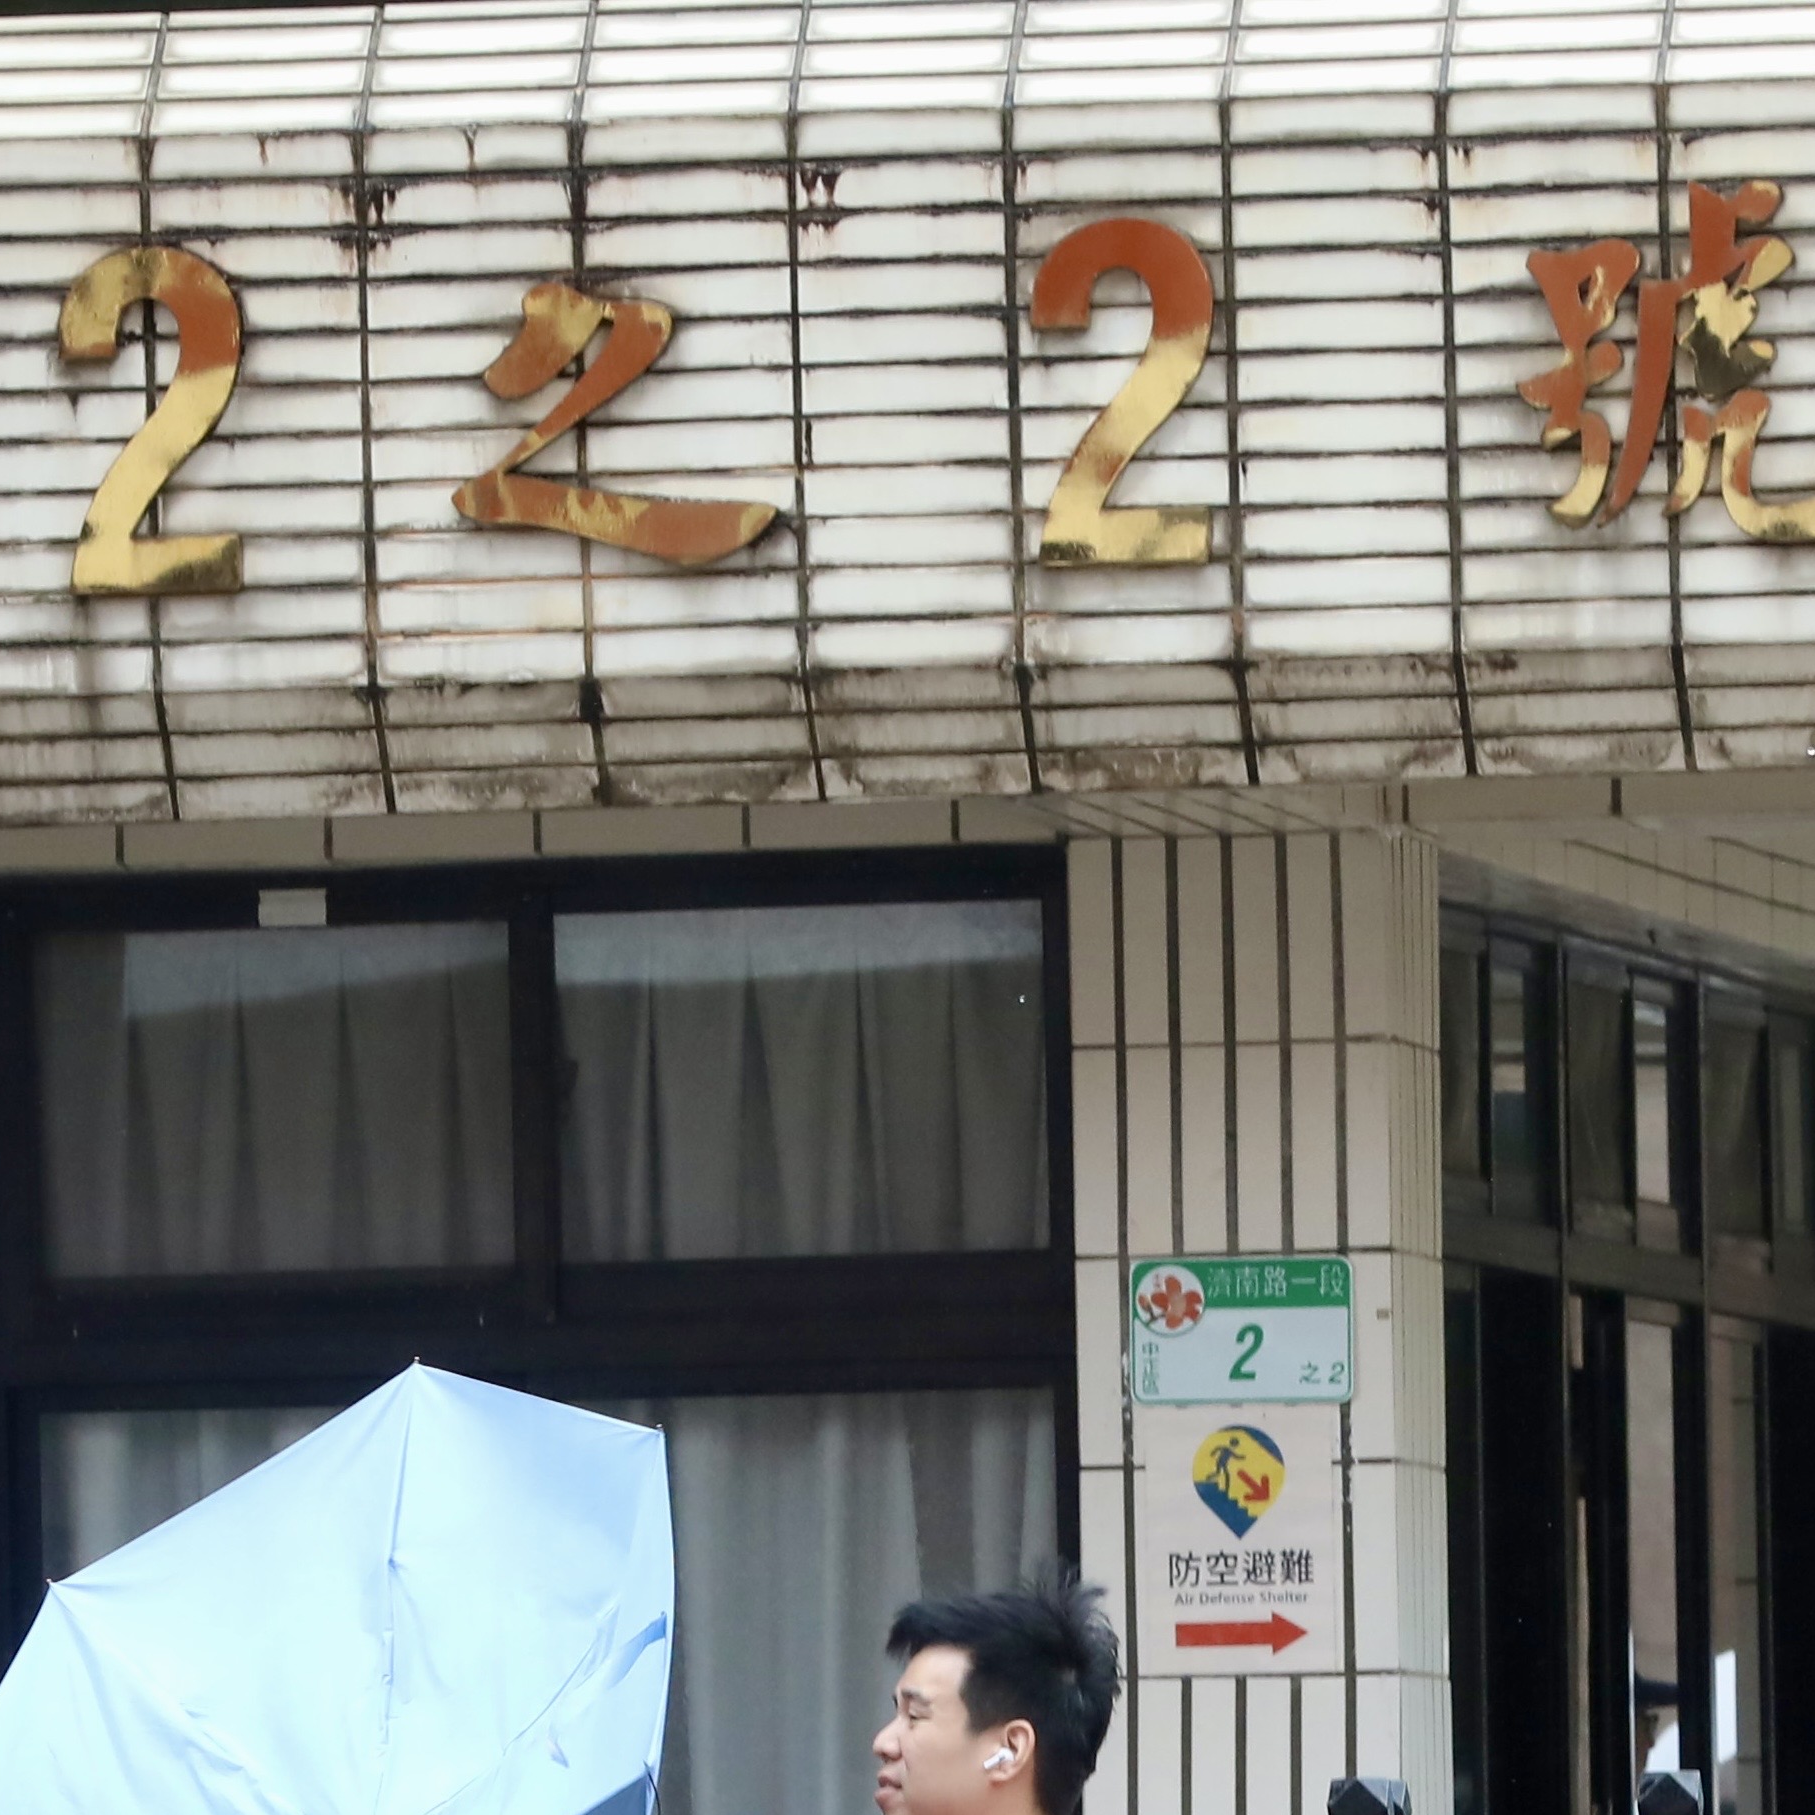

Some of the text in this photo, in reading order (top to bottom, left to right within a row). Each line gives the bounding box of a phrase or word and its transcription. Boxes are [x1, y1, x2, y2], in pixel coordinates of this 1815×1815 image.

[1228, 1323, 1264, 1382] 2
[1169, 1550, 1314, 1588] 防空避難
[1174, 1589, 1308, 1606] Air Defense Shelter
